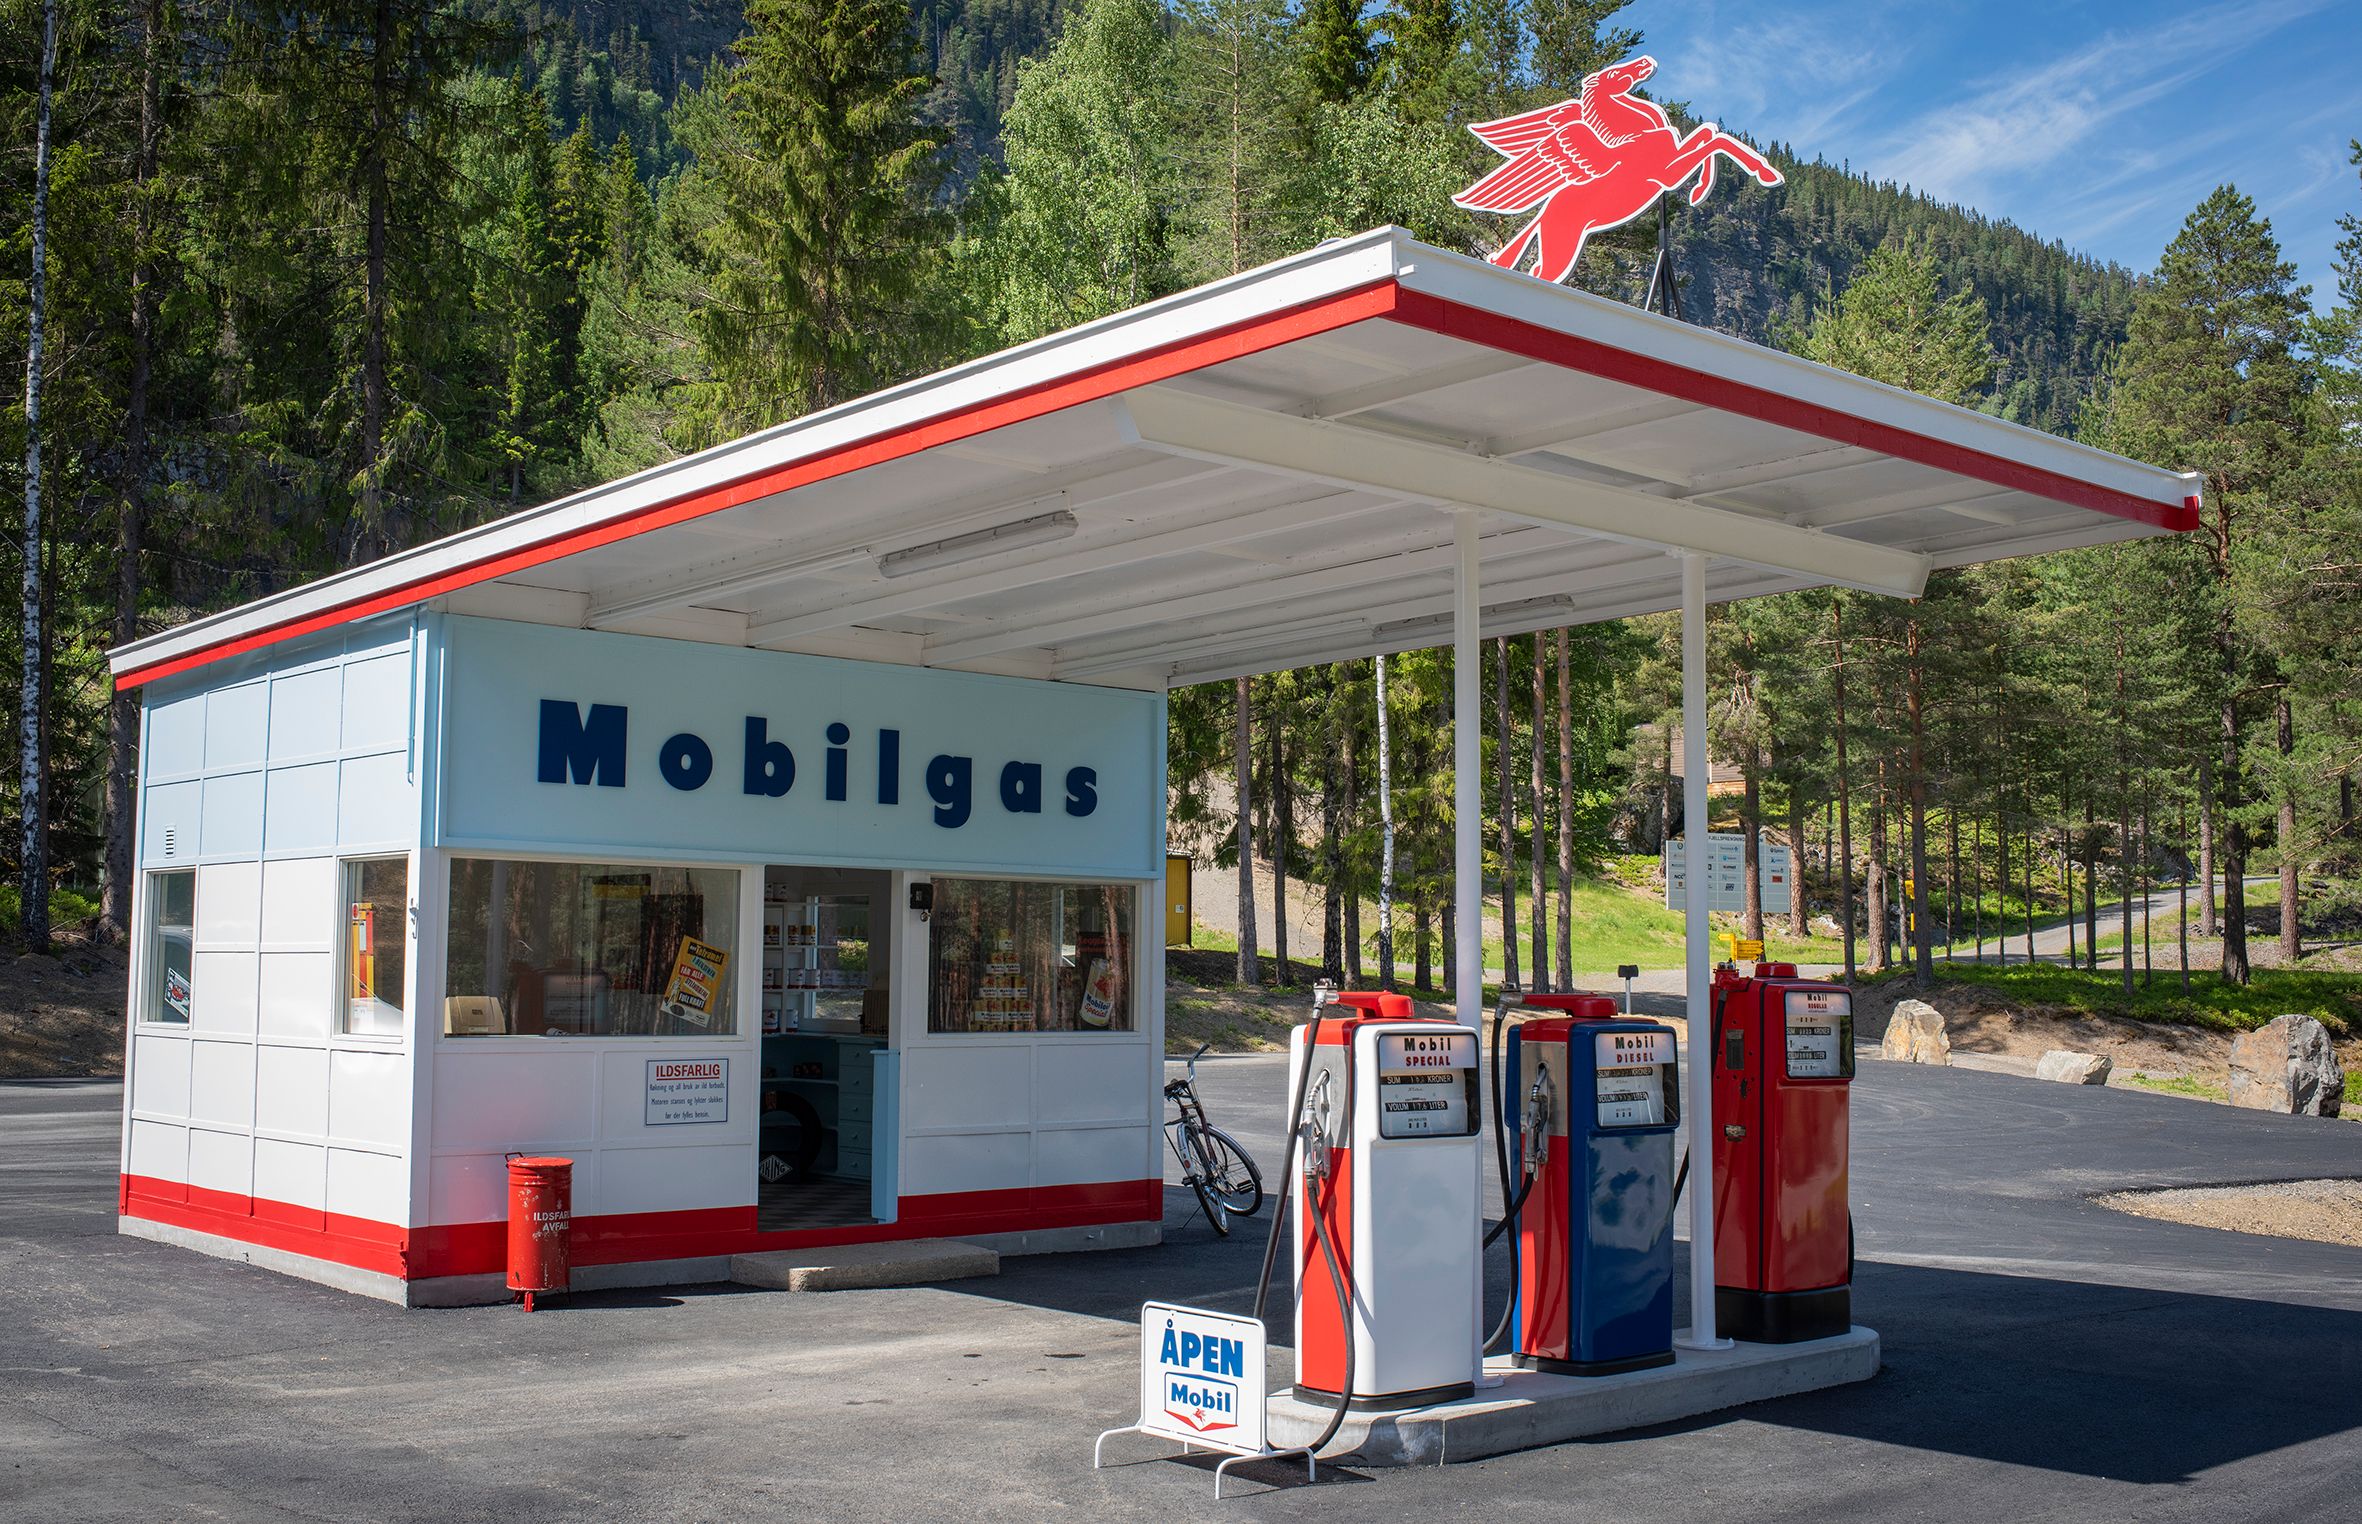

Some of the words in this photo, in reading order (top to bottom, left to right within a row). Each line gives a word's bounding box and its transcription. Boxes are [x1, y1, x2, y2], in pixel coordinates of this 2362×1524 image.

[538, 698, 1098, 829] Mobilgas
[1086, 993, 1110, 1010] Mobiloil
[1404, 1037, 1451, 1051] Mobil
[1615, 1036, 1654, 1049] Mobil
[1406, 1056, 1451, 1067] SPECIAL
[1616, 1053, 1654, 1063] DIESEL
[656, 1064, 720, 1077] ILDSFARLIG
[1427, 1075, 1452, 1083] KRONER
[683, 1082, 693, 1090] bruk
[1388, 1103, 1409, 1111] VOLUM
[1429, 1101, 1446, 1109] LITER
[760, 1157, 785, 1179] IKING
[533, 1211, 570, 1221] ILDSFAR
[1160, 1318, 1243, 1378] ÅPEN
[1171, 1382, 1231, 1413] Mobil
